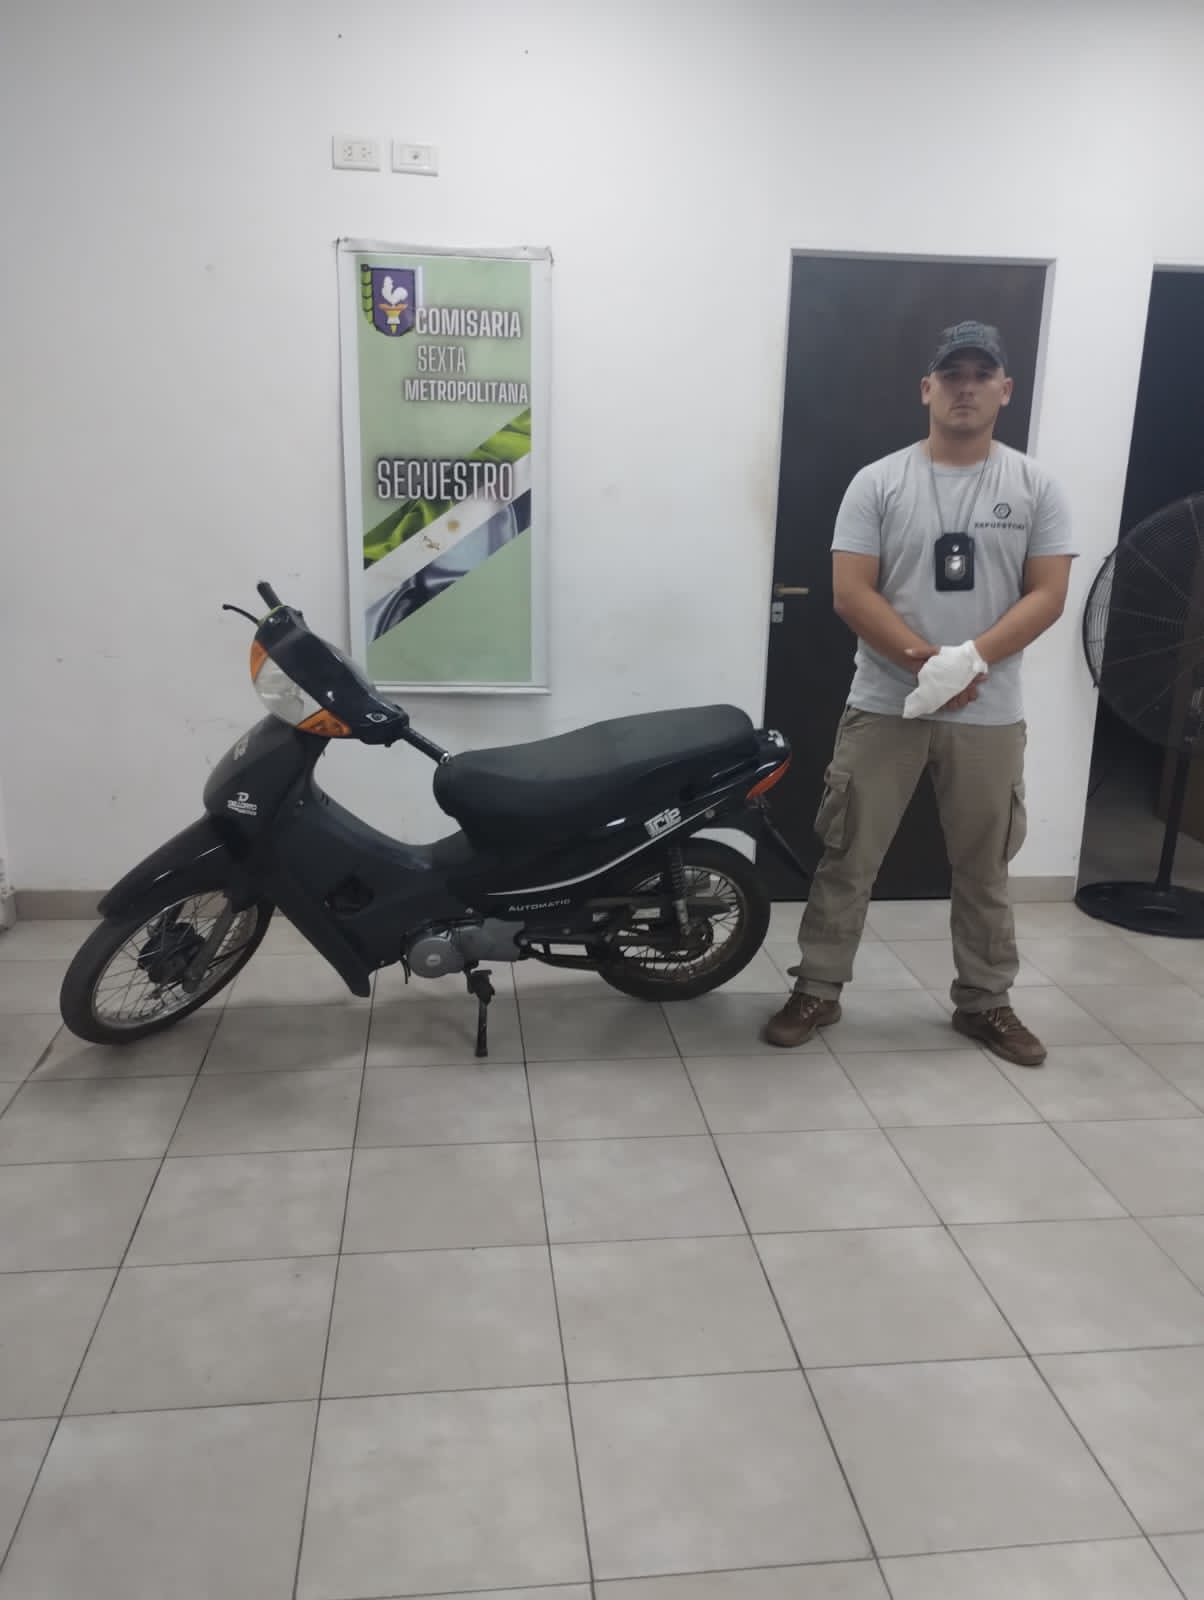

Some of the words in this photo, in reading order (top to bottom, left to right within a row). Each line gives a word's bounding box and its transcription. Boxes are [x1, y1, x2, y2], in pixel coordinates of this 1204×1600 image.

[415, 307, 521, 337] COMISARIA
[417, 345, 467, 373] SEXTA
[405, 379, 528, 404] METROPOLITANA
[377, 459, 513, 501] SECUESTRO
[508, 898, 571, 912] AUTOMATIC
